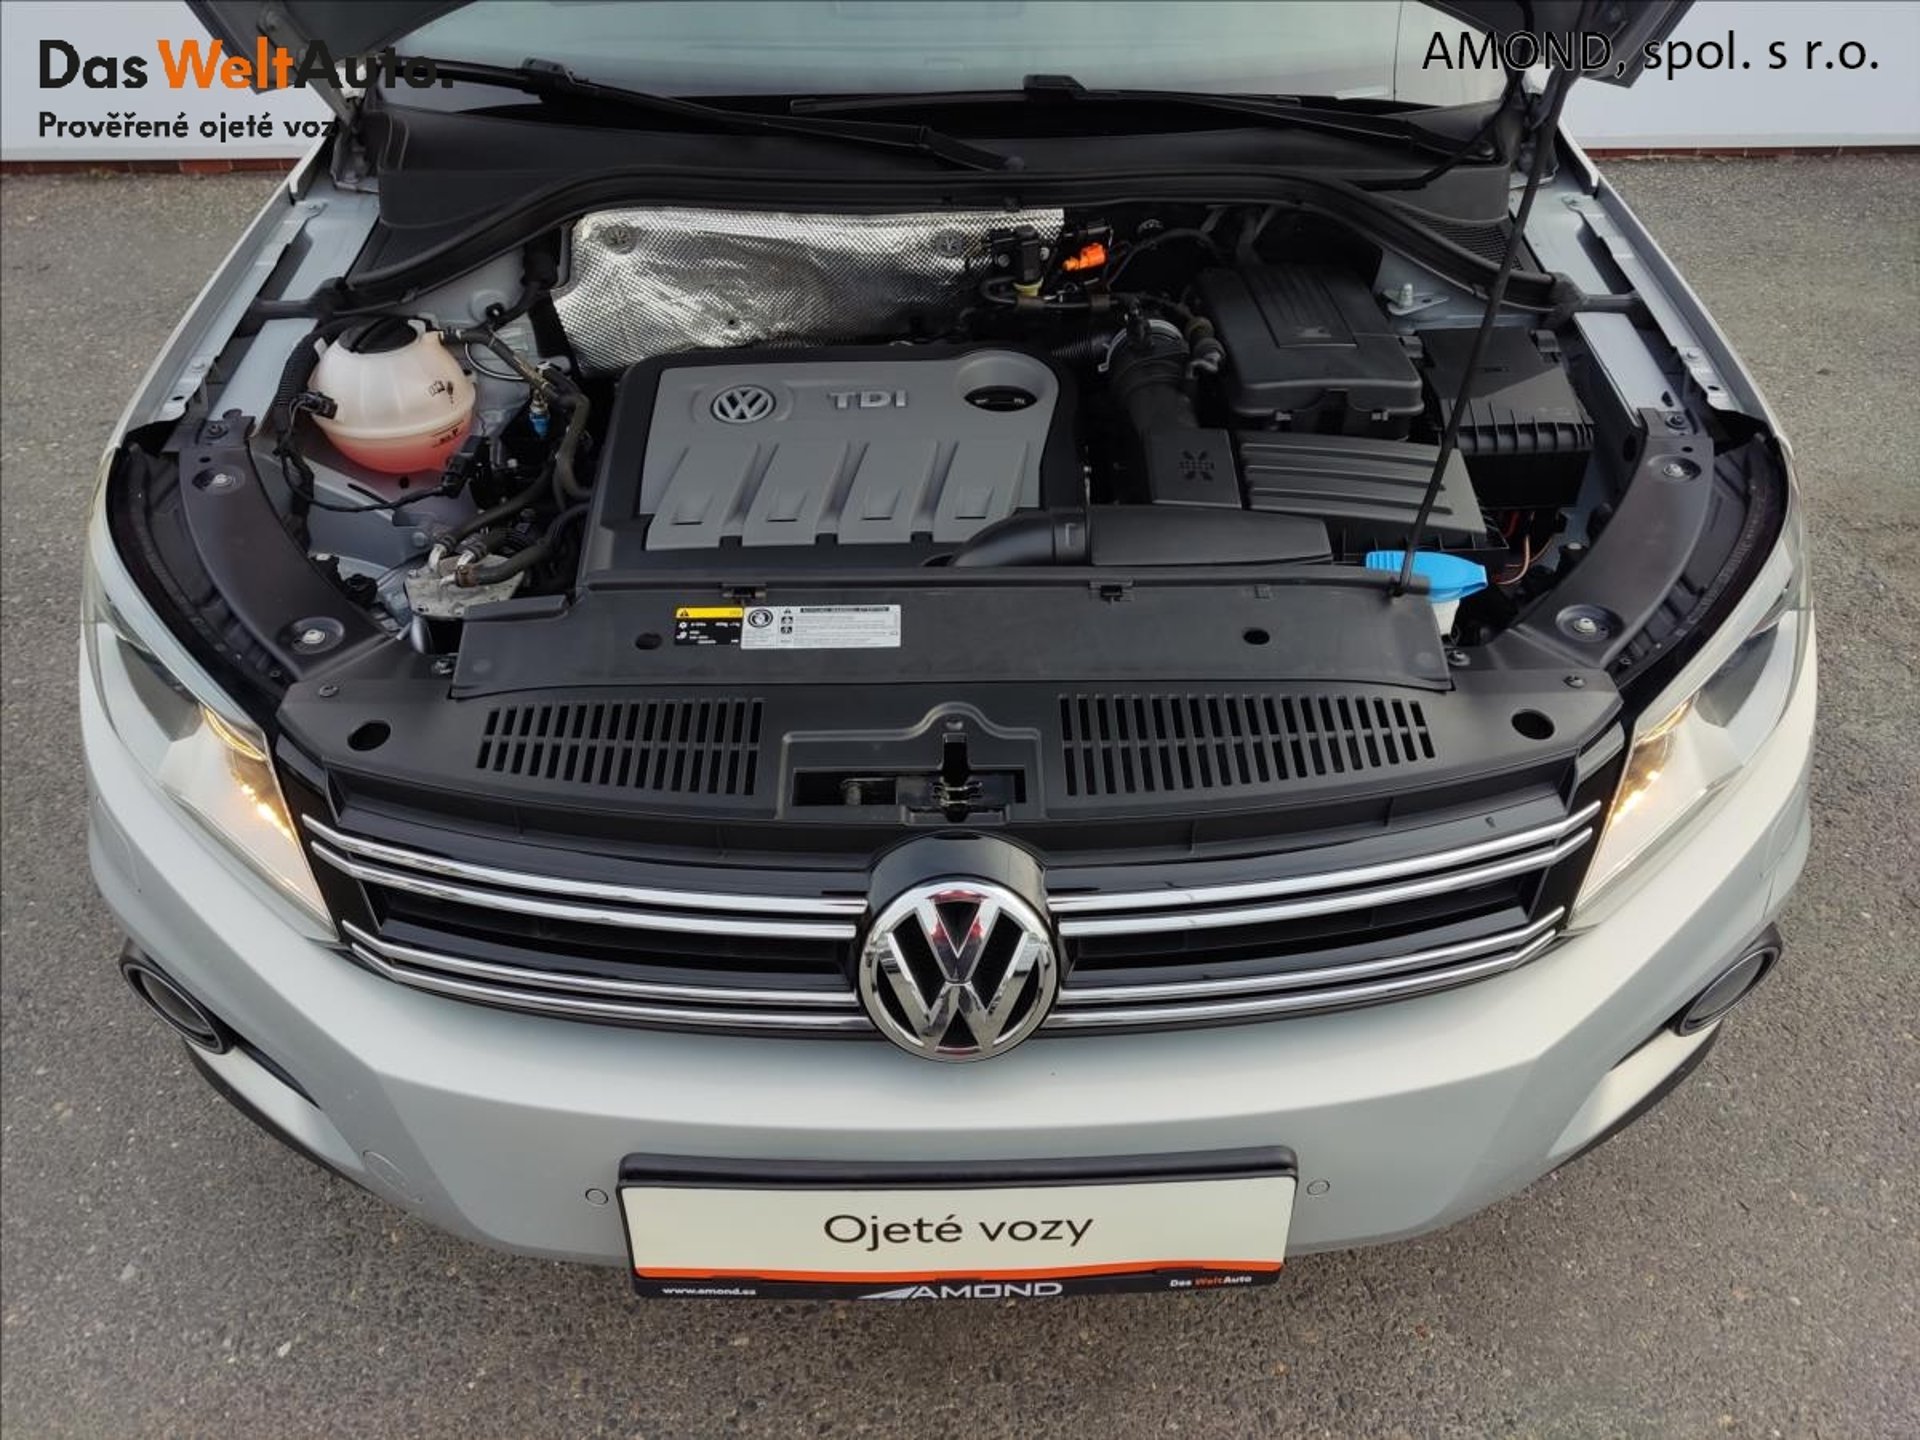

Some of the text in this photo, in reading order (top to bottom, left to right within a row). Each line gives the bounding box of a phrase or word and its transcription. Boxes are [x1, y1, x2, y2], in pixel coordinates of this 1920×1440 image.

[828, 389, 907, 410] TDI
[824, 1214, 1093, 1251] Ojeté vozy
[911, 1282, 1063, 1299] AMOND
